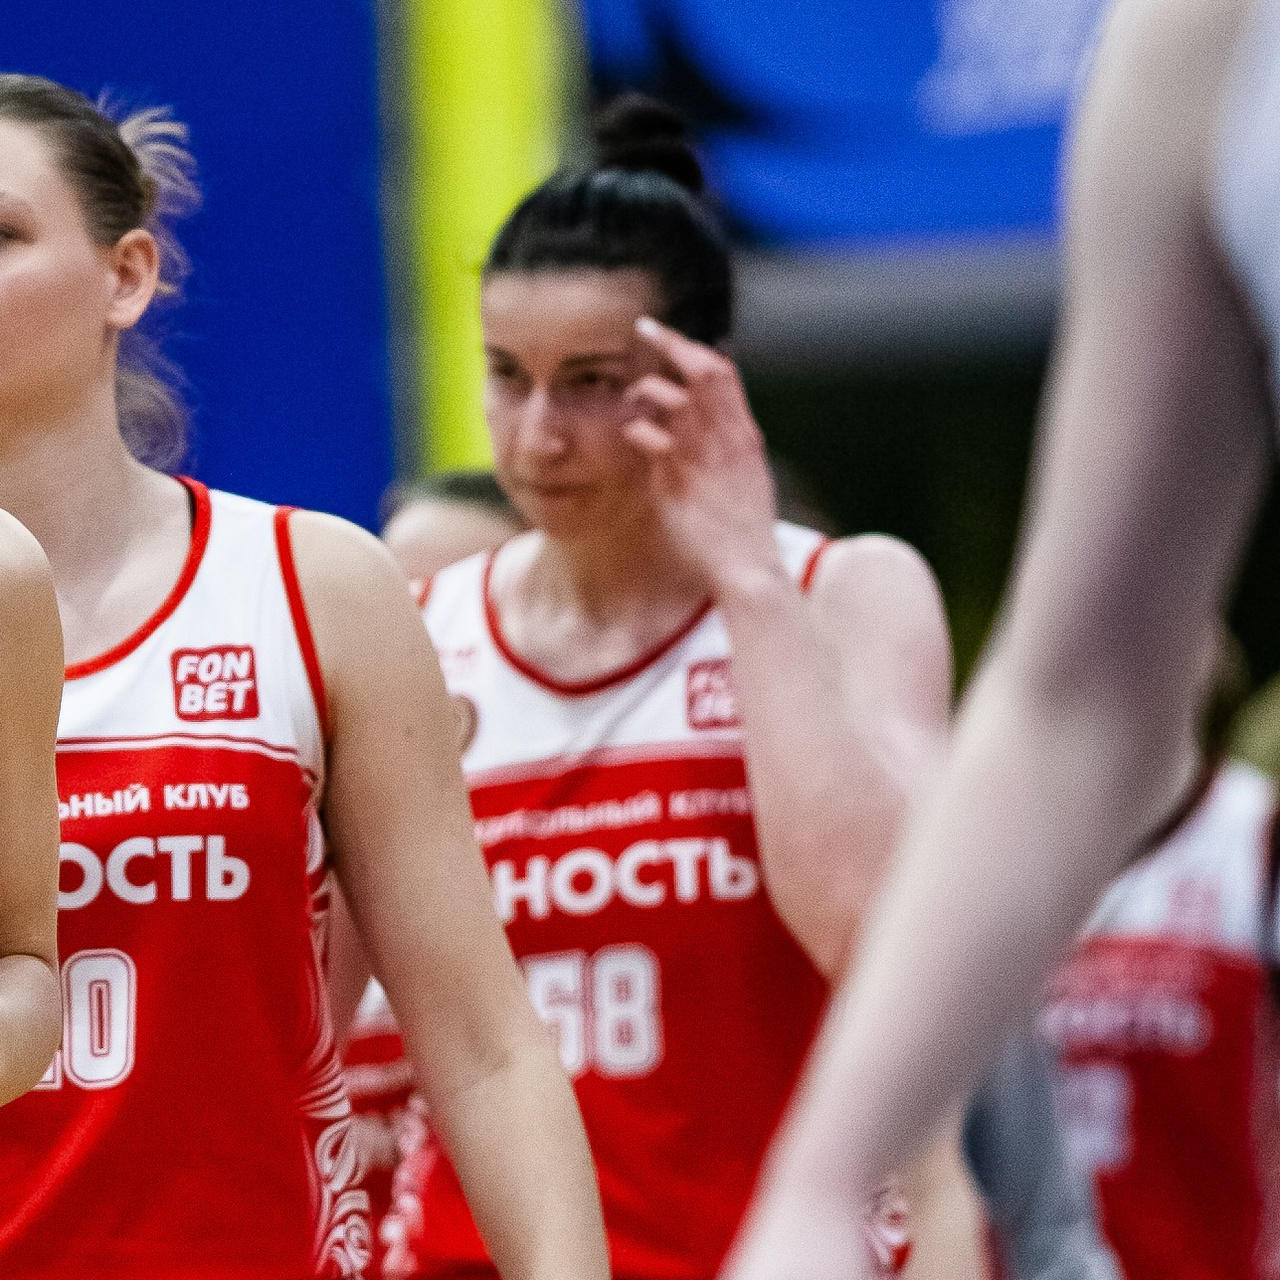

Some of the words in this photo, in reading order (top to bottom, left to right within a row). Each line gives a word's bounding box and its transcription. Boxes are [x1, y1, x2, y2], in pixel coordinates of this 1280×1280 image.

[175, 651, 251, 682] FON
[179, 679, 253, 714] BET
[163, 783, 250, 810] КЛУБ
[33, 948, 137, 1091] 0
